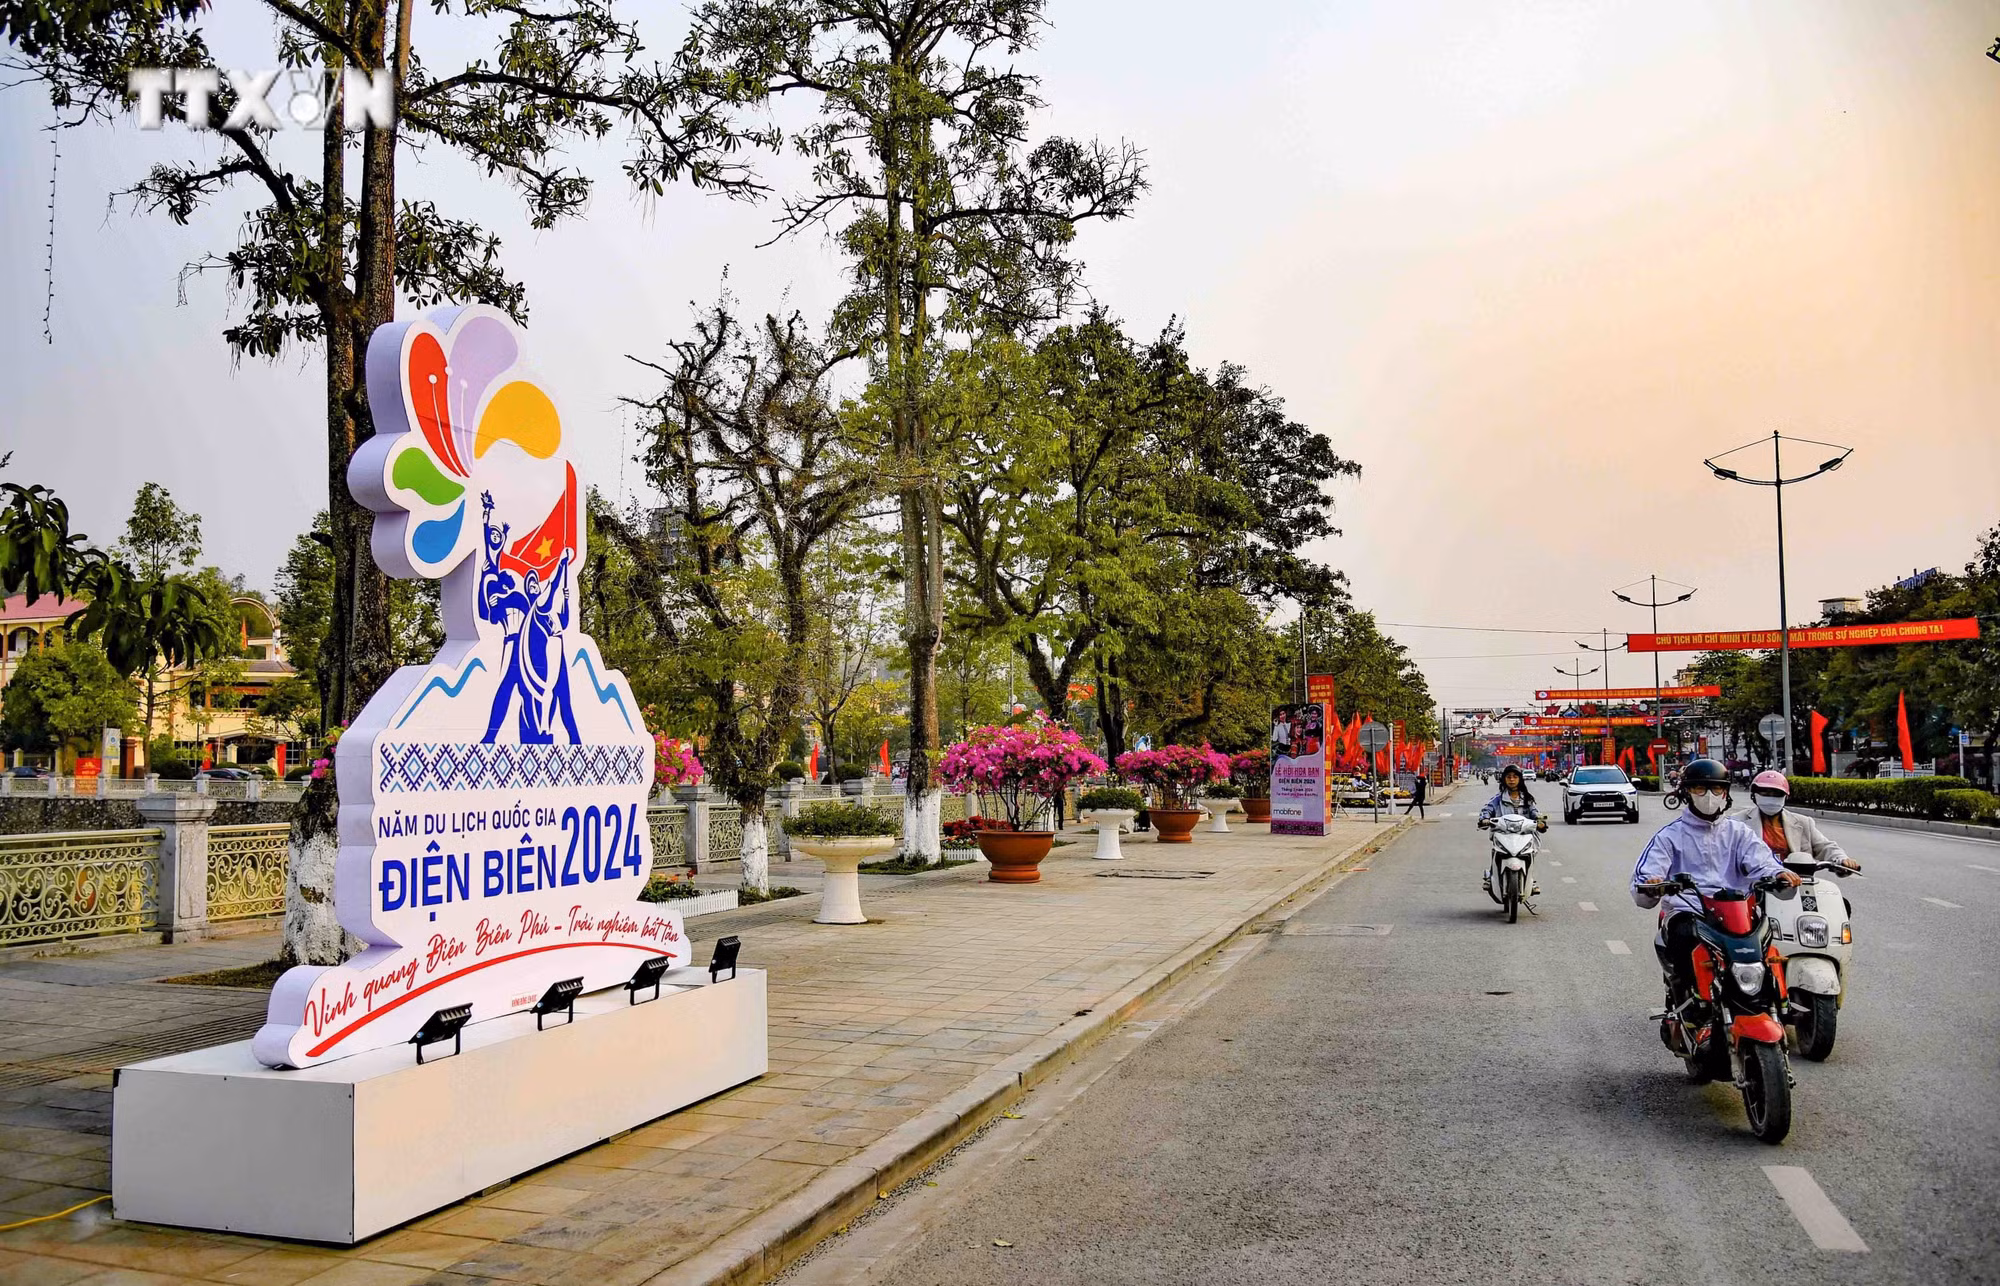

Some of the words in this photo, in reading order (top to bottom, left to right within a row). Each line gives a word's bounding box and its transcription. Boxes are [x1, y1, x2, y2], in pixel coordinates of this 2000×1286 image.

[1655, 634, 1672, 646] CHỦ
[1673, 635, 1691, 646] TỊCH
[1692, 633, 1704, 645] HỒ
[1704, 632, 1718, 644] CHÍ
[1719, 633, 1741, 644] MINH
[1751, 632, 1765, 645] ĐẠI
[1766, 631, 1783, 643] SỐN
[1789, 630, 1806, 642] MÃI
[1807, 631, 1834, 642] TRONG
[1835, 629, 1847, 641] SỰ
[1848, 627, 1879, 640] NGHIỆP
[1880, 626, 1898, 638] CỦA
[1899, 625, 1928, 637] CHÚNG
[1928, 624, 1944, 635] TA!
[1294, 767, 1307, 776] HOA
[1307, 767, 1320, 776] BAN
[378, 809, 418, 838] NĂM
[424, 813, 446, 835] DU
[452, 811, 487, 839] LỊCH
[492, 799, 531, 830] QUỐC
[535, 807, 557, 827] GIA
[1273, 807, 1302, 816] mobifone
[378, 839, 470, 922] ĐIỆN
[483, 832, 557, 898] BIÊN
[560, 803, 642, 887] 2024
[303, 981, 358, 1037] Vinh
[363, 957, 420, 1012] quang
[426, 933, 467, 974] Điện
[475, 917, 513, 957] Biên
[596, 911, 639, 942] nghiệm
